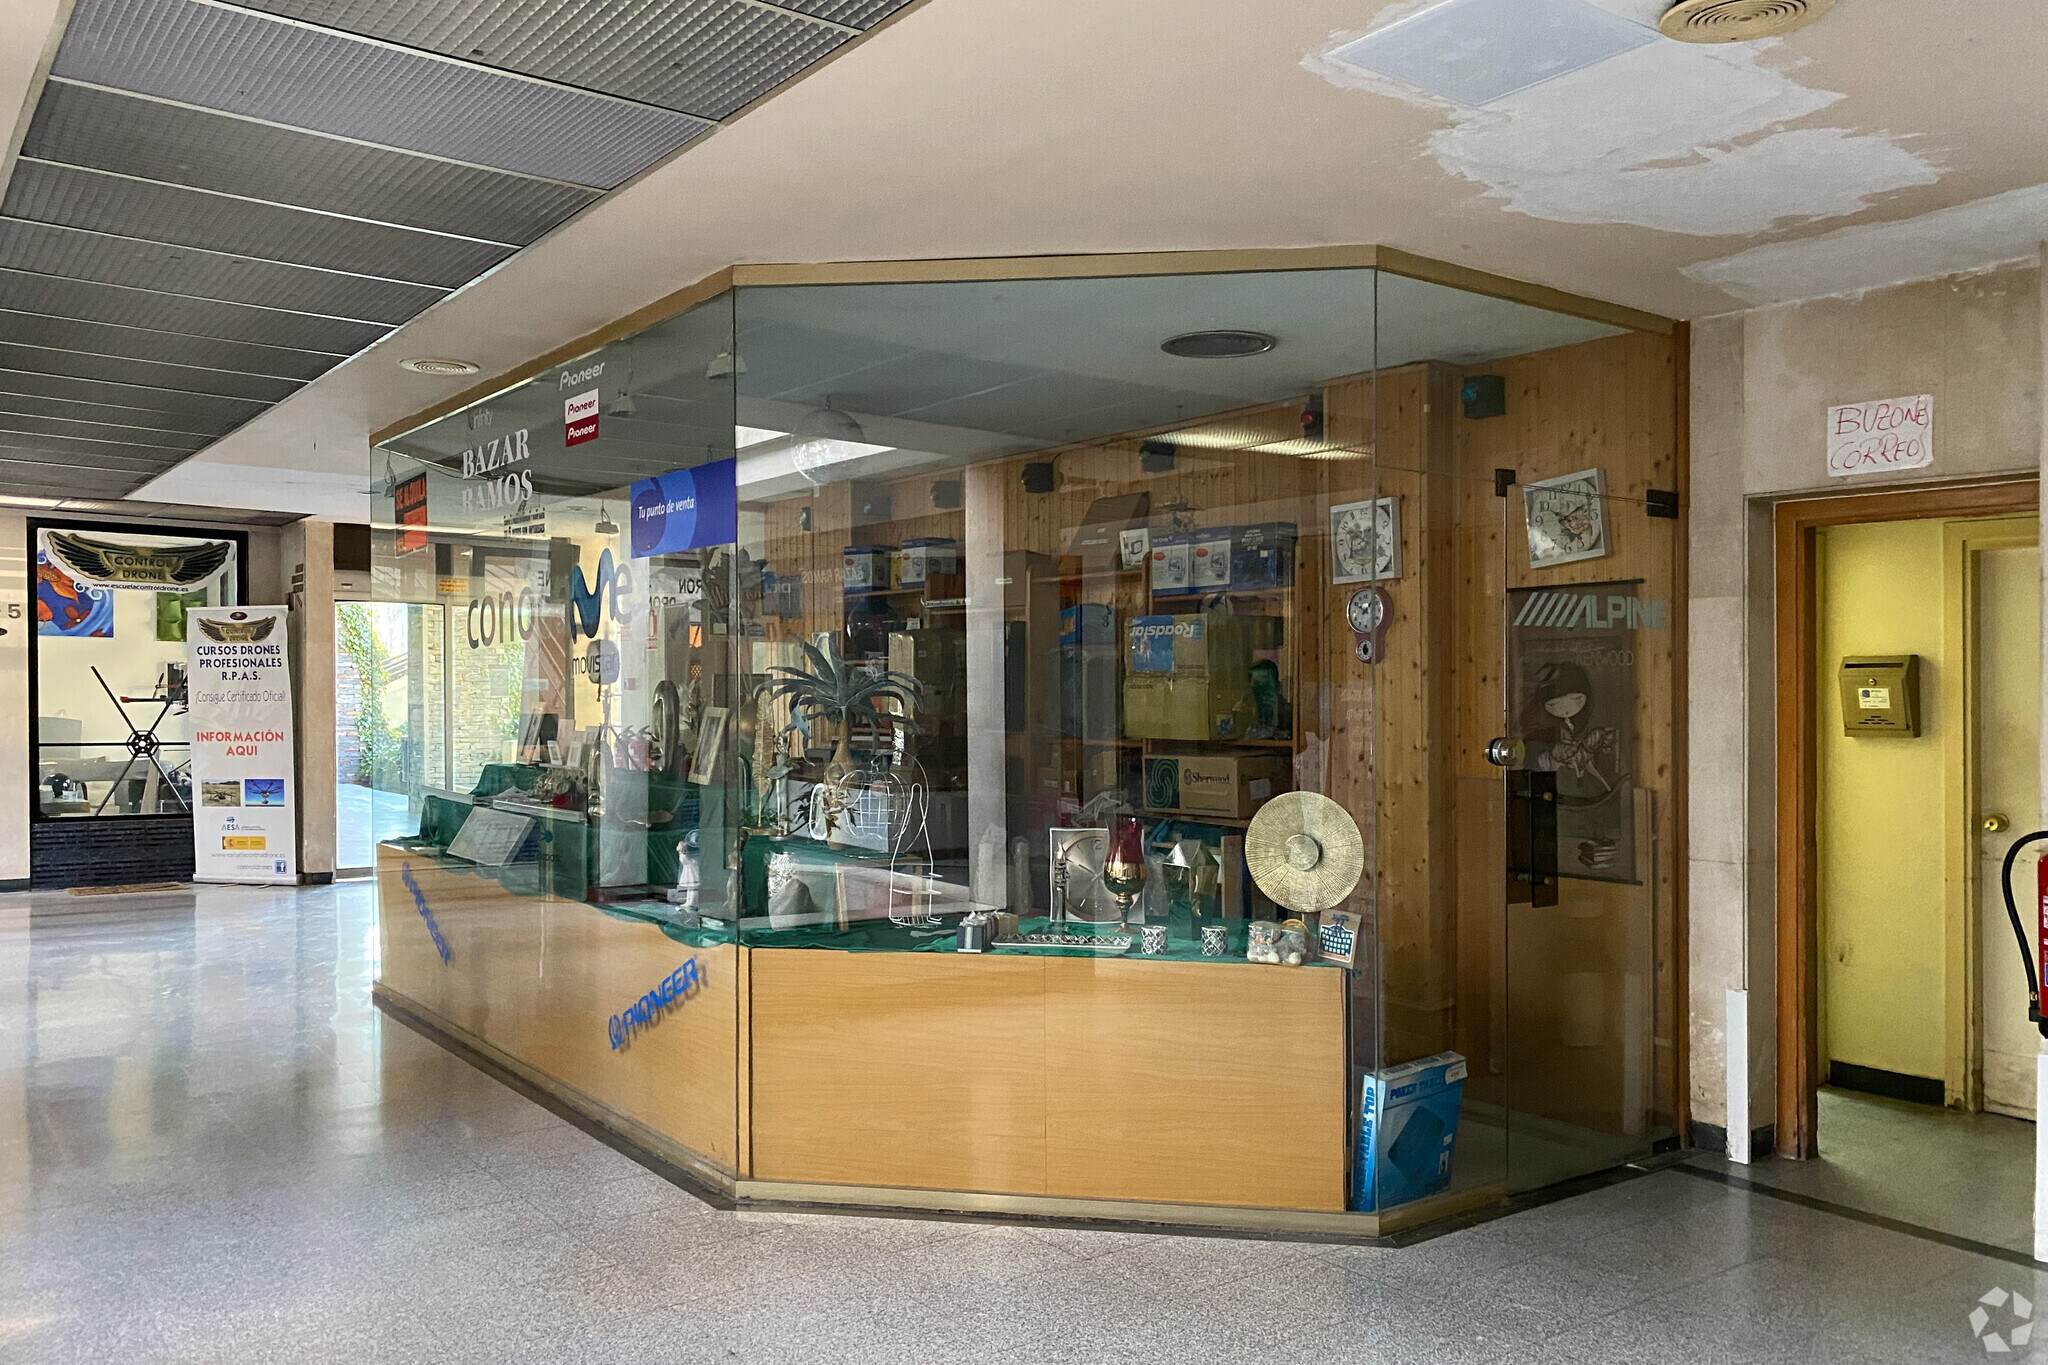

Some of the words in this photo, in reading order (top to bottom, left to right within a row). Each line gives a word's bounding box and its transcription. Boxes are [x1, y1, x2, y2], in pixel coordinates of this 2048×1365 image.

[559, 361, 605, 391] Pioneer
[567, 399, 596, 415] Pioneer
[1835, 396, 1929, 434] BUZONES
[567, 423, 596, 440] Pioneer
[462, 428, 530, 479] BAZAR
[1831, 432, 1926, 469] CORREOS
[462, 469, 533, 514] RAMOS
[638, 506, 645, 519] Tu
[646, 502, 665, 521] punto
[667, 500, 674, 514] de
[676, 496, 694, 511] venta
[114, 556, 172, 568] CONTROL
[122, 569, 164, 580] DRONE
[93, 582, 189, 592] www.escuelacontroldrone.es
[8, 604, 21, 619] 5
[1565, 595, 1668, 631] ALPINE
[1130, 621, 1195, 639] Roadstar
[197, 645, 237, 655] CURSOS
[241, 645, 280, 655] DRONES
[200, 658, 282, 669] PROFESIONALES
[222, 671, 261, 681] R.P.A.S.
[227, 691, 260, 702] Certificado
[196, 729, 284, 742] INFORMACIÓN
[226, 746, 257, 756] AQUI
[1192, 773, 1230, 784] Sherwood
[622, 957, 699, 1035] PIONEER
[1363, 1086, 1375, 1115] TOP
